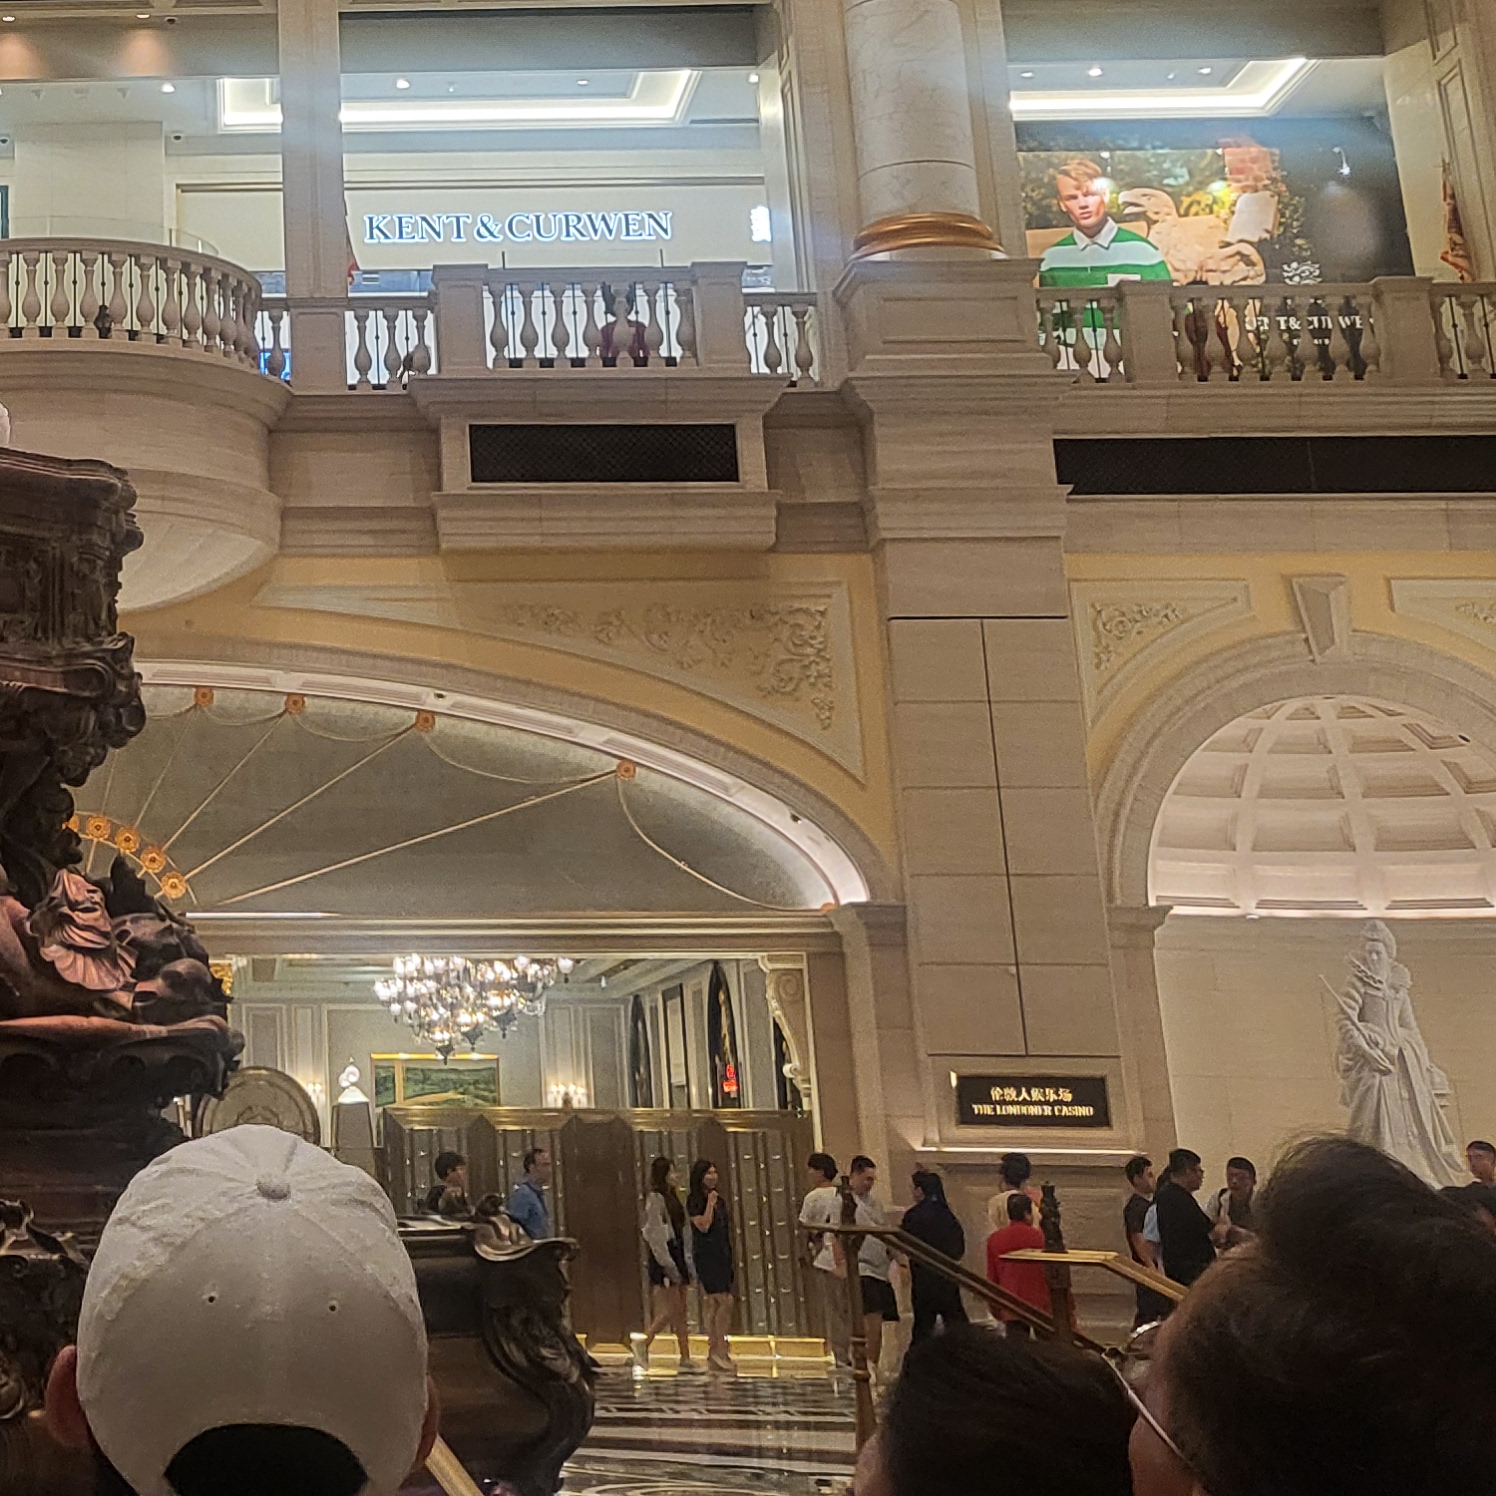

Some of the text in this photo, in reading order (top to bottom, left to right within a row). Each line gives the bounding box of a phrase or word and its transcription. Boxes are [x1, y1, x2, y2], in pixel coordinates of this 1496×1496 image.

[364, 211, 672, 242] KENT & CURWEN
[972, 1104, 1094, 1116] THE LONDONER CASINO
